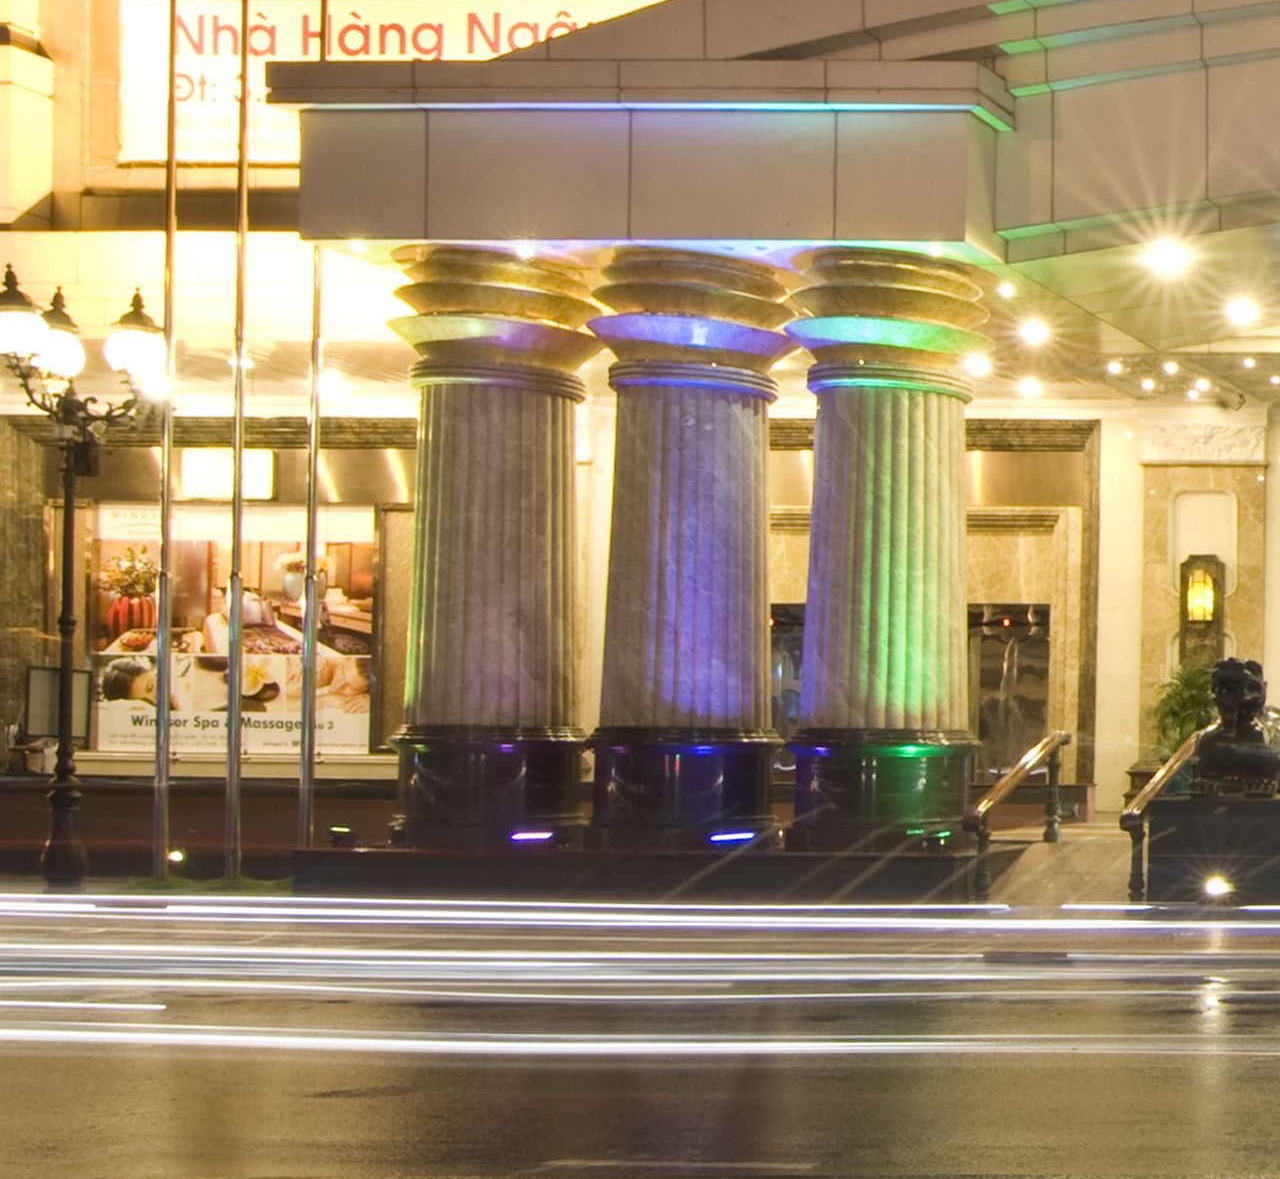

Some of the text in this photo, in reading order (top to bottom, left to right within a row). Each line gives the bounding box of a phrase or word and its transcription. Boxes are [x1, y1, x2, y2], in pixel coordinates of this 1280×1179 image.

[175, 10, 595, 62] Nhà Hàng Ngâ
[131, 715, 189, 728] Winsor
[193, 716, 221, 732] Spa
[241, 717, 302, 733] Massage
